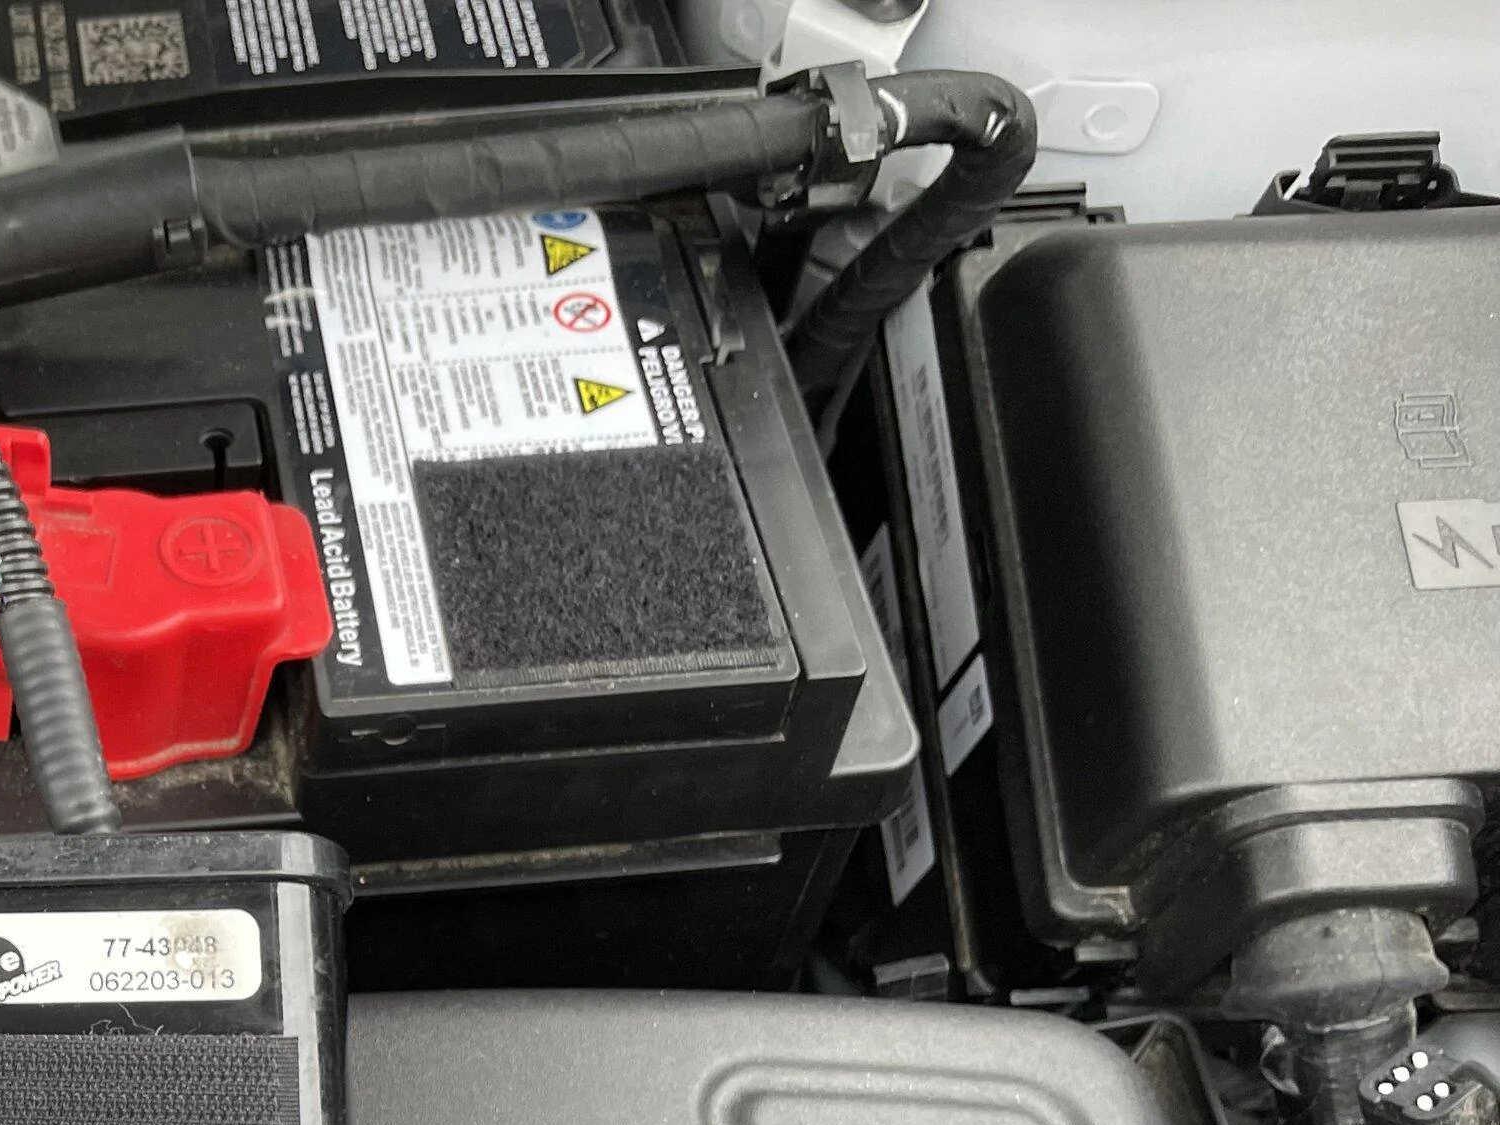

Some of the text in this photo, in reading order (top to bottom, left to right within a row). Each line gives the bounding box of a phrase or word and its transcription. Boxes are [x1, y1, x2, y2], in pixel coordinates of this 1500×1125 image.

[638, 345, 677, 427] PELIGRO
[661, 345, 700, 421] DANGER
[310, 467, 342, 525] Lead
[320, 525, 353, 581] Acid
[329, 577, 364, 667] Battery
[89, 968, 236, 992] 062203-013
